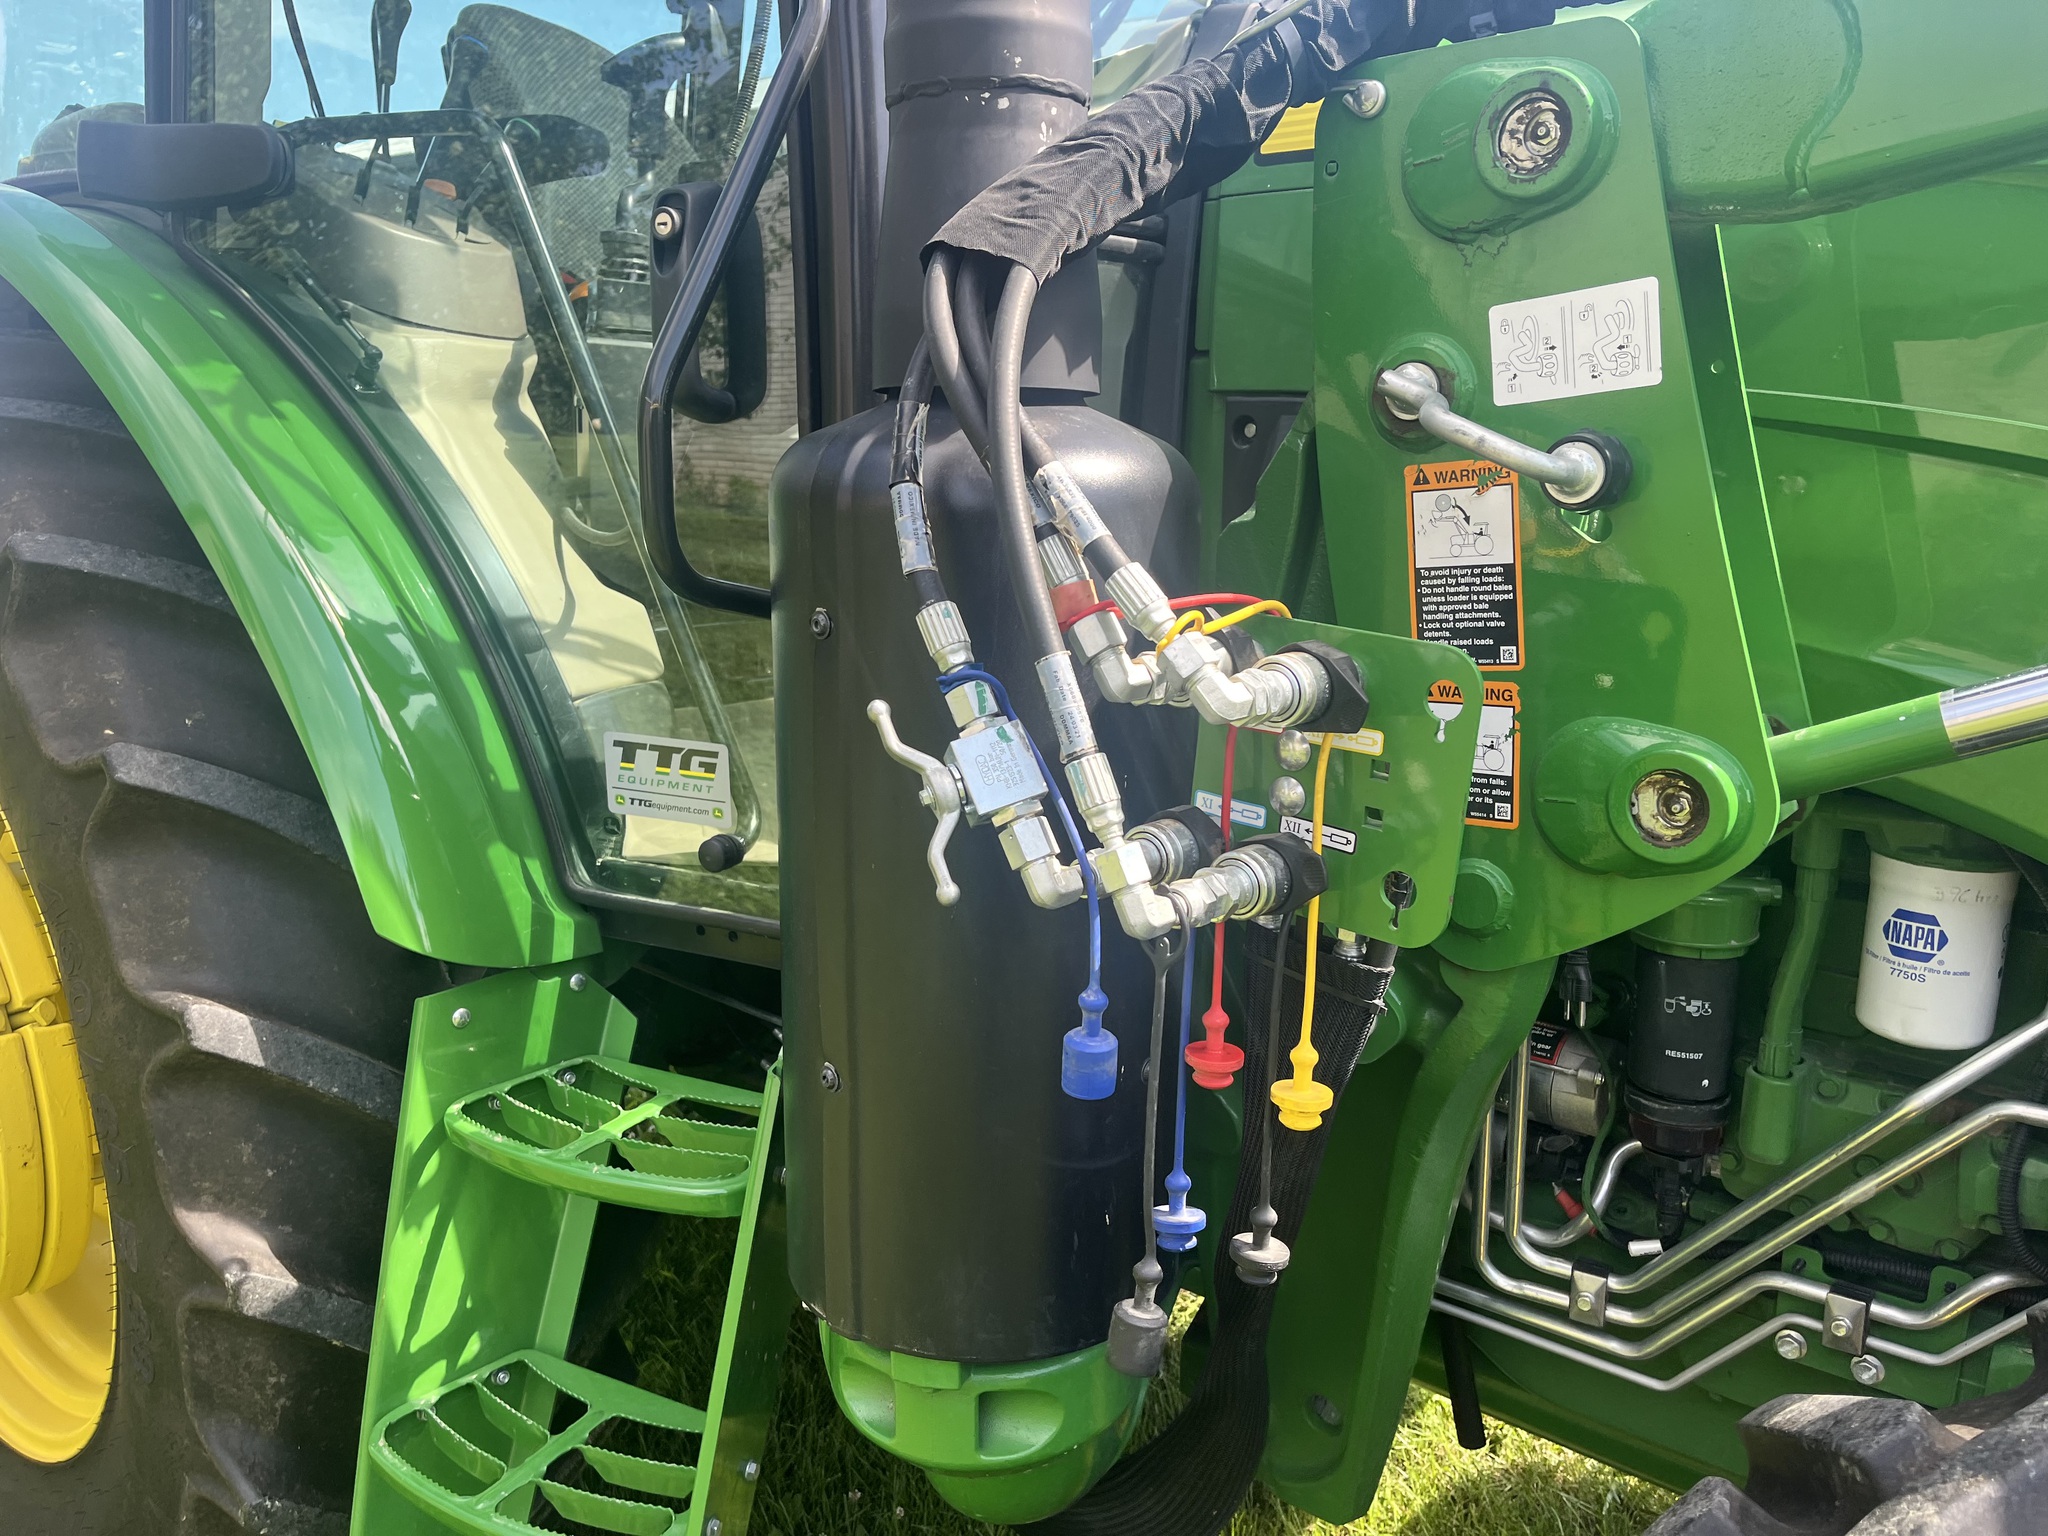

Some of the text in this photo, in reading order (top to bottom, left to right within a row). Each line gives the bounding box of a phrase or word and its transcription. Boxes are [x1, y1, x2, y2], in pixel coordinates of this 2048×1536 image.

[1479, 593, 1513, 601] equipped
[1439, 603, 1472, 612] approved
[1455, 620, 1484, 629] optional
[613, 740, 719, 781] TTG
[617, 774, 714, 793] EQUIPMENT
[629, 797, 709, 816] TTGequipment.com
[1201, 796, 1213, 810] XI
[1284, 819, 1301, 834] XII
[1891, 920, 1934, 951] NAPA
[1890, 967, 1926, 983] 7750S
[1665, 1050, 1703, 1059] RE551507
